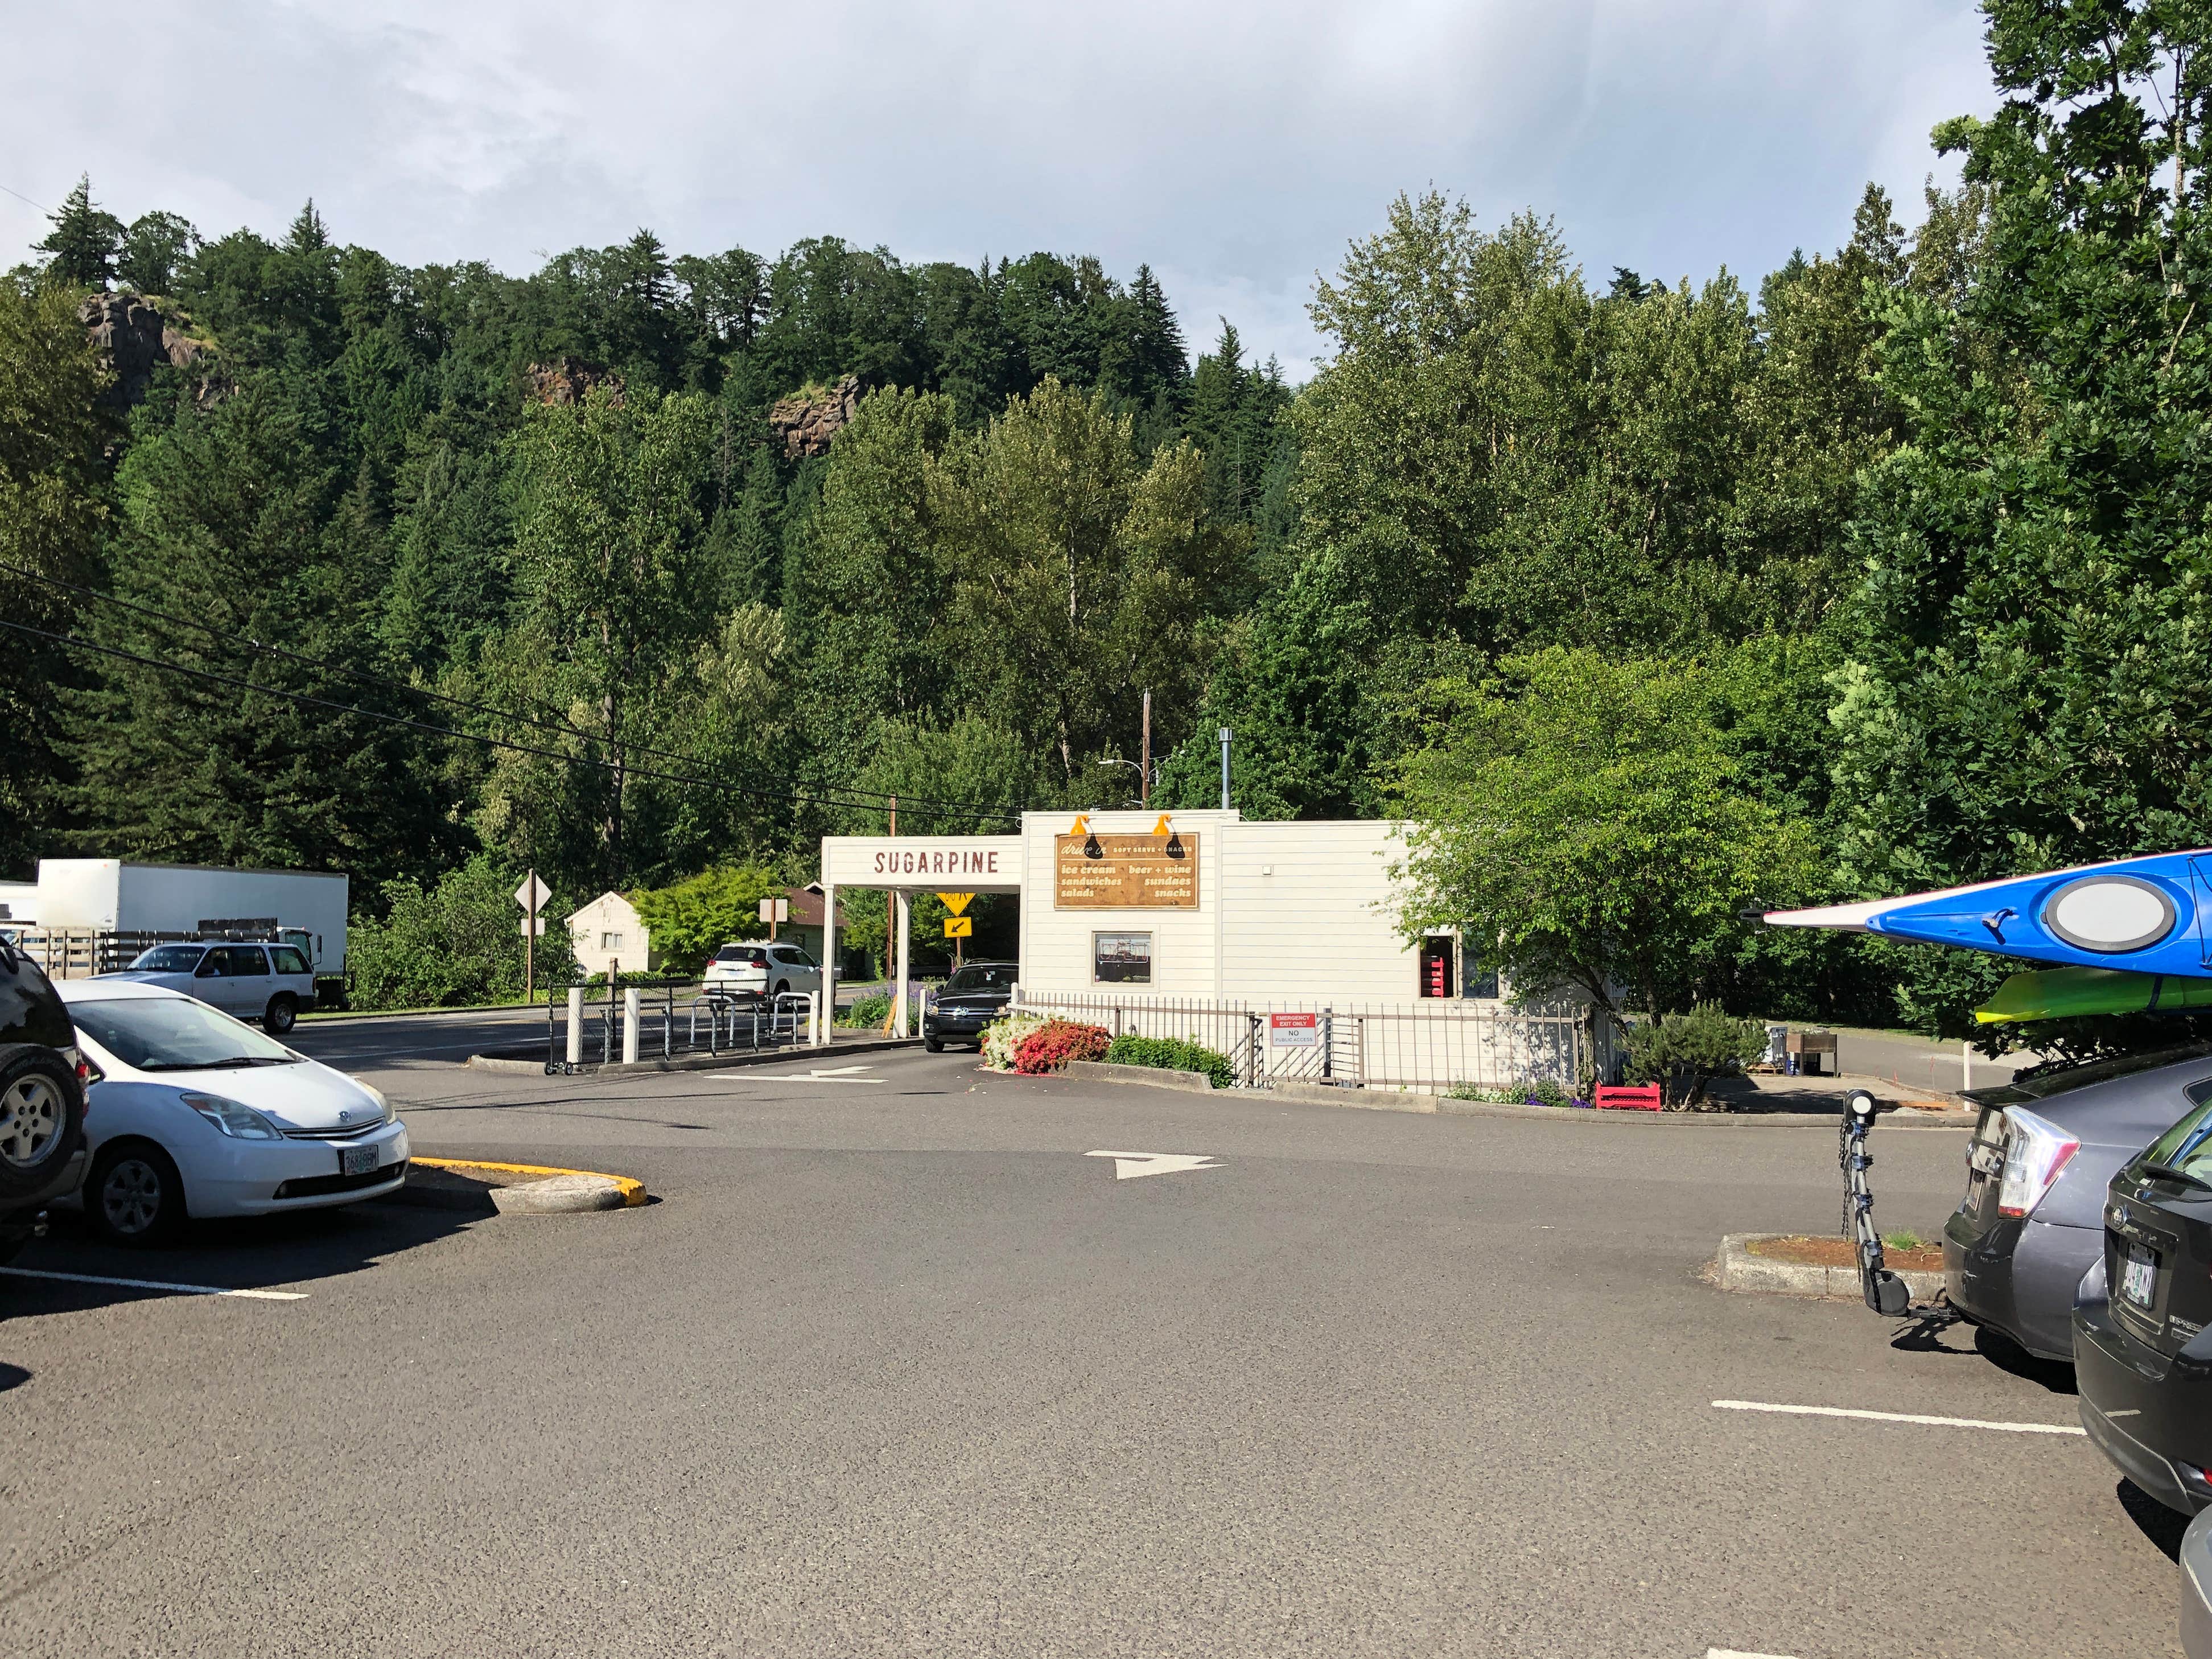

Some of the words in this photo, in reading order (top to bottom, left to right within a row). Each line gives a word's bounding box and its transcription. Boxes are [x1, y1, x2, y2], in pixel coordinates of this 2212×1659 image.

[1061, 842, 1093, 855] drive
[1095, 842, 1107, 855] in
[874, 851, 998, 874] SUGARPINE
[1061, 865, 1078, 874] ice
[1128, 865, 1153, 874] beer
[1164, 864, 1192, 874] wine
[1061, 876, 1122, 886] sandwiches
[1144, 875, 1192, 886] sundaes
[1061, 888, 1094, 898] salads
[1155, 888, 1192, 898] snacks
